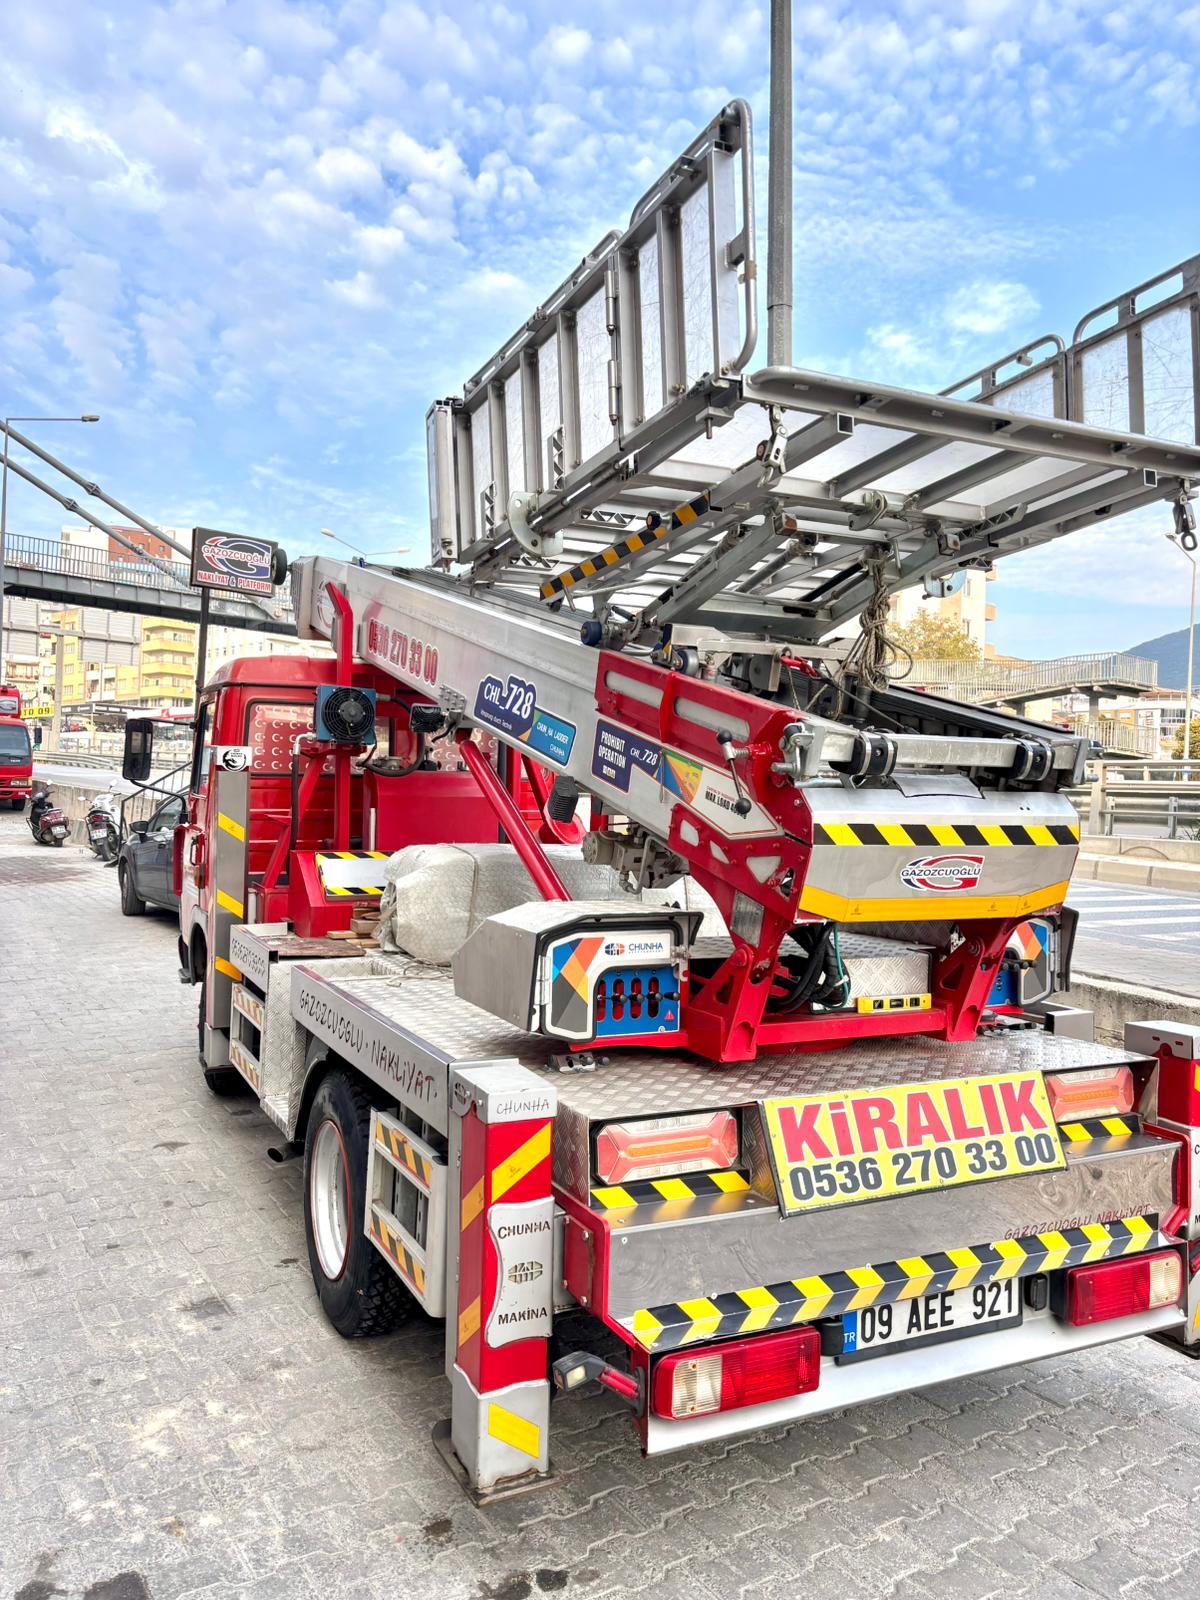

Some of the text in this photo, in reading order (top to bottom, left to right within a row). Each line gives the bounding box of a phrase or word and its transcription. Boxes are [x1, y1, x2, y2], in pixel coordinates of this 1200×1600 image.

[229, 576, 237, 587] &
[238, 577, 271, 593] PLATFORM
[390, 629, 408, 669] 270
[410, 638, 423, 677] 33
[424, 645, 438, 686] 00
[553, 730, 569, 745] LADDER
[600, 730, 626, 752] PROHIBIT
[598, 744, 627, 769] OPERATION
[717, 796, 730, 810] LOAD
[629, 942, 663, 951] CHUNHA
[497, 1097, 549, 1115] CHUNHA
[789, 1133, 1056, 1200] 0536 270 33 00
[498, 1220, 551, 1239] CHUNHA
[498, 1307, 548, 1325] MAKİNA
[844, 1279, 1013, 1343] TR 09 AEE 921
